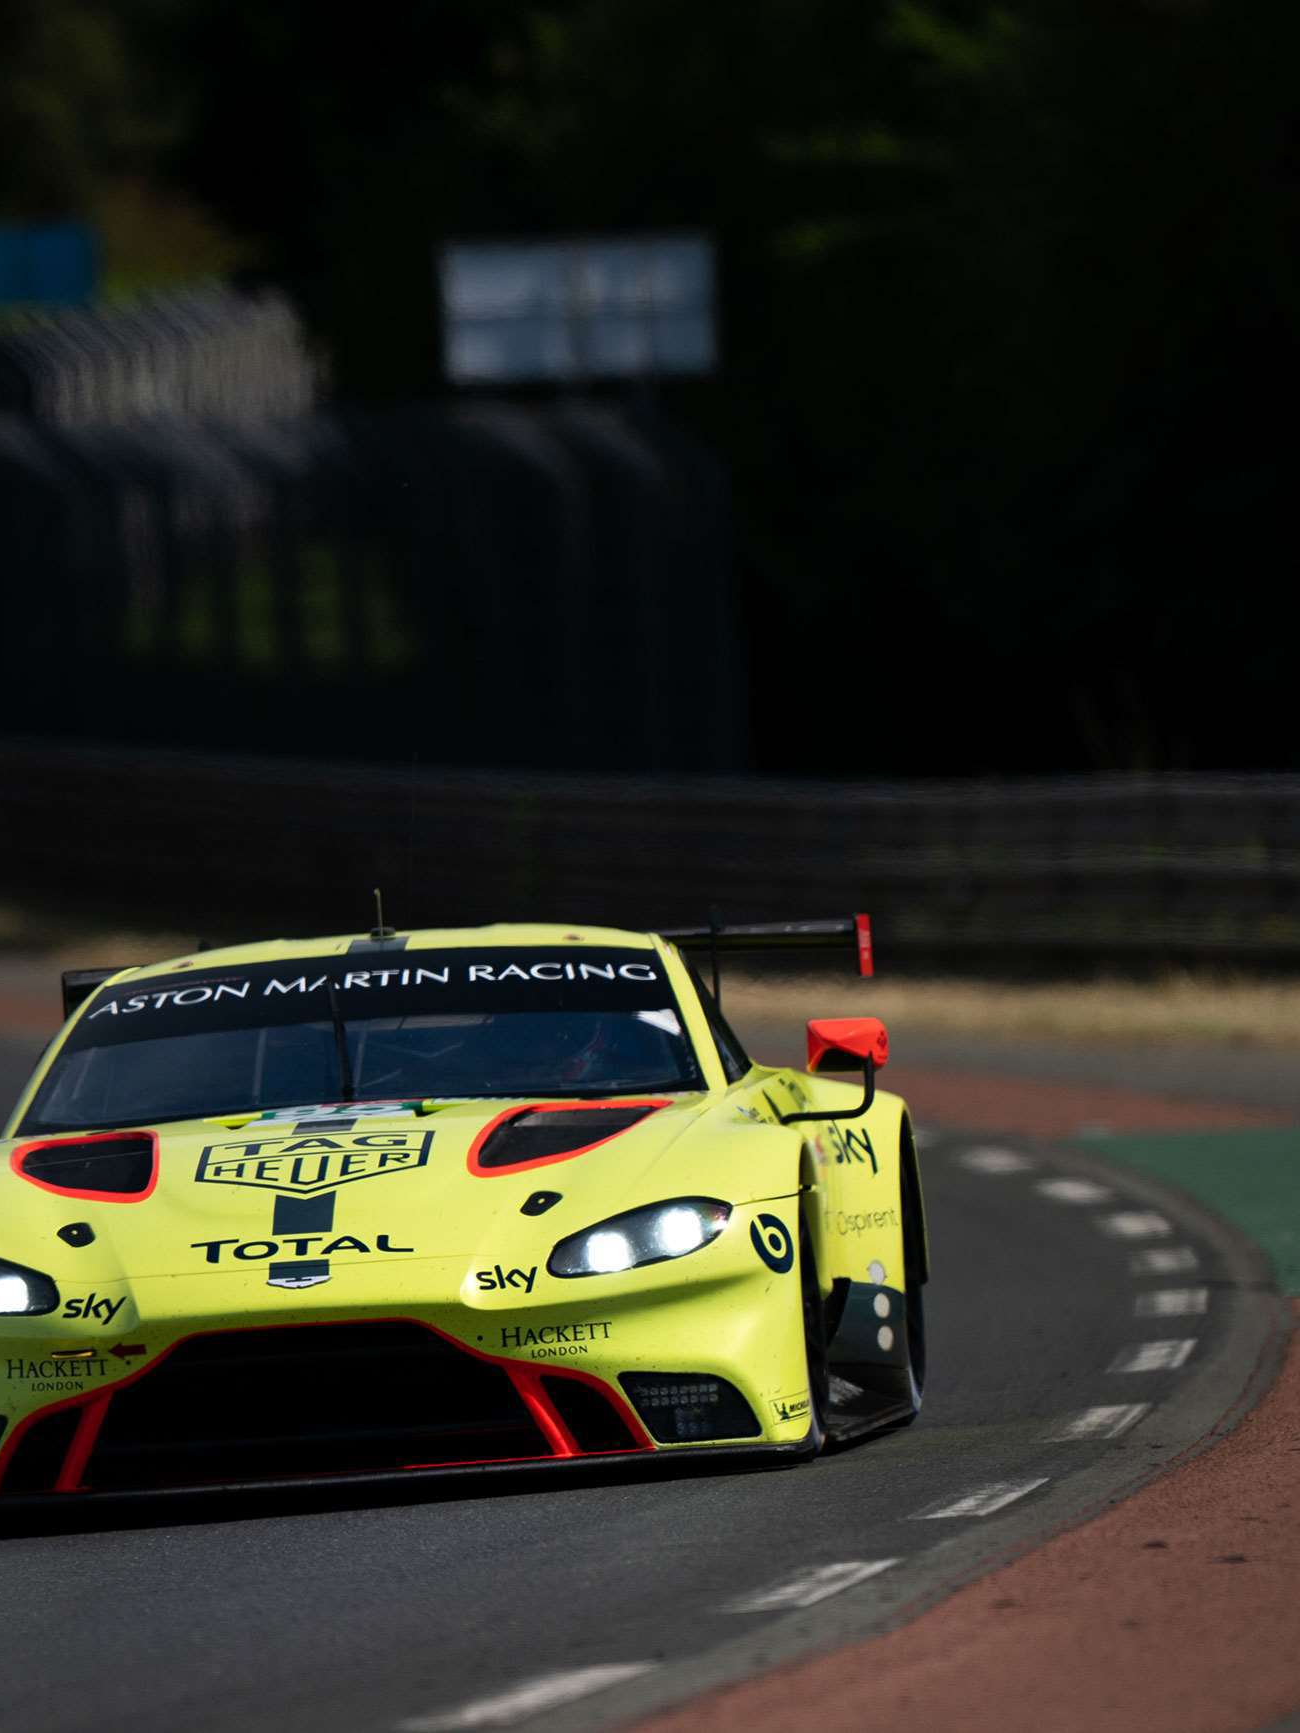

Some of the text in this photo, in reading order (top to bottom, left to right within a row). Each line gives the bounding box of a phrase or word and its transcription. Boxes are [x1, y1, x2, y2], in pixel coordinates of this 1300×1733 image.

[88, 982, 250, 1020] ASTON
[263, 967, 450, 996] MARTIN
[468, 963, 658, 982] RACING
[224, 1134, 408, 1157] TAG
[213, 1152, 411, 1186] HEUER
[190, 1234, 415, 1264] TOTAL
[475, 1264, 538, 1294] sky
[61, 1293, 128, 1326] sky
[501, 1321, 613, 1348] HACKETT
[531, 1345, 588, 1359] LONDON
[6, 1357, 109, 1379] HACKETT
[31, 1381, 84, 1392] LONDON
